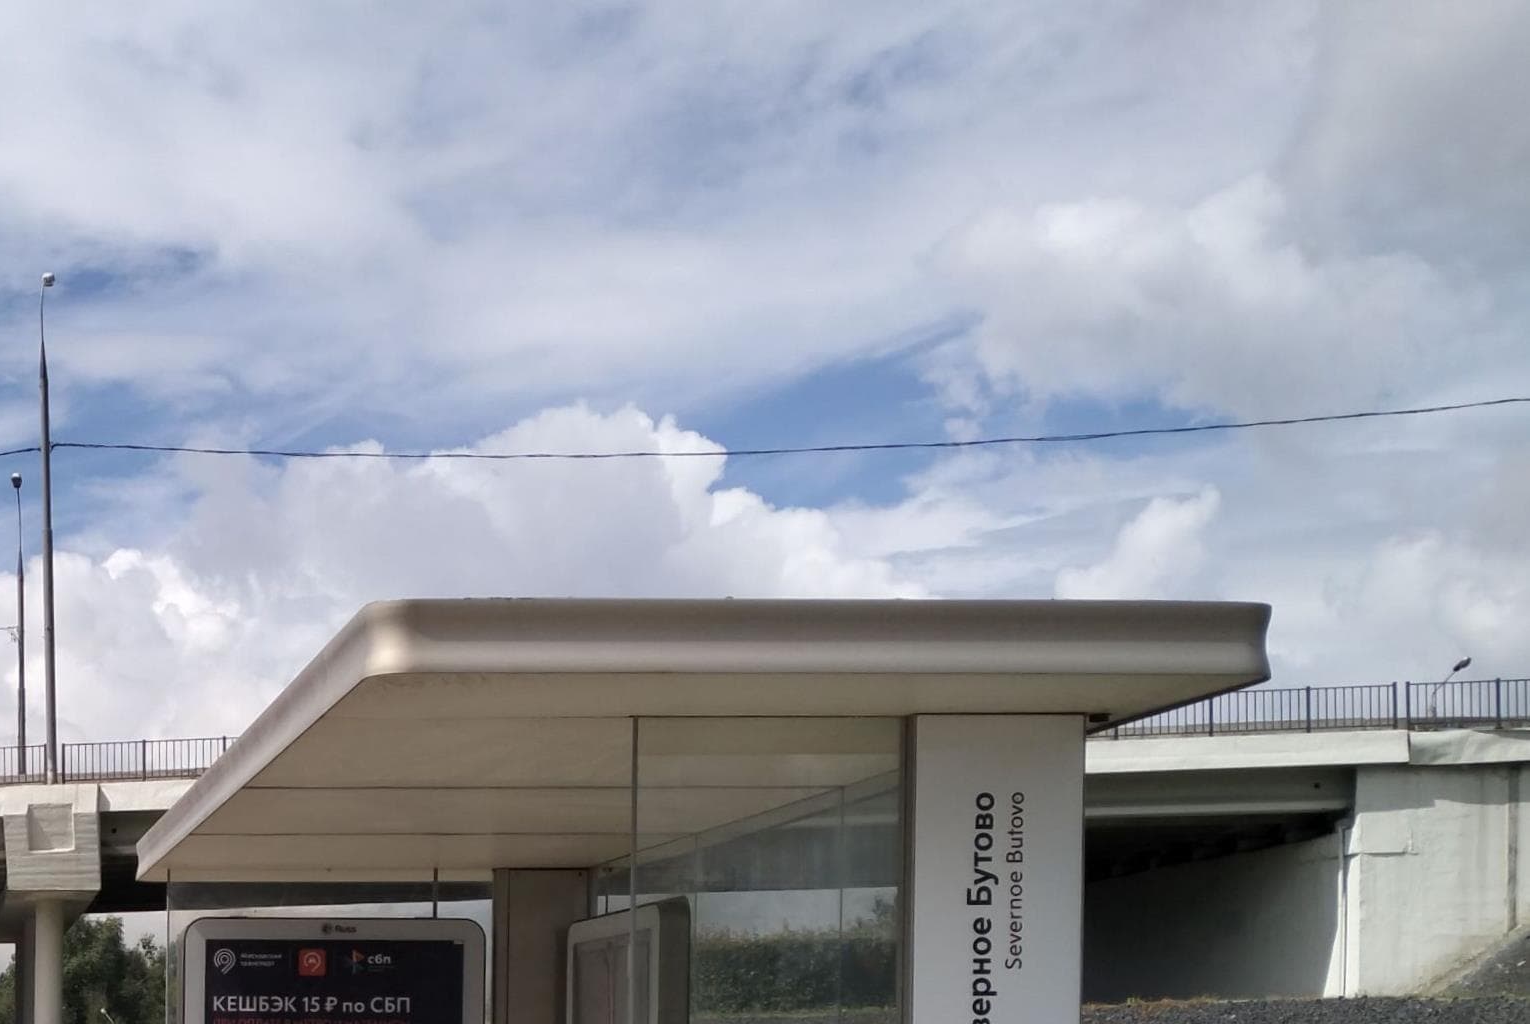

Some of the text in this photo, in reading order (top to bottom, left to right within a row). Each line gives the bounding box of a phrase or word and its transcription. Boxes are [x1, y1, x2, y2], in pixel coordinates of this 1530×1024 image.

[966, 791, 999, 906] Бутово
[1005, 791, 1026, 969] Severnoe Butovo
[213, 996, 297, 1012] КЕШБЭК
[301, 996, 320, 1012] 15
[342, 1002, 365, 1013] по
[370, 996, 411, 1013] СБП
